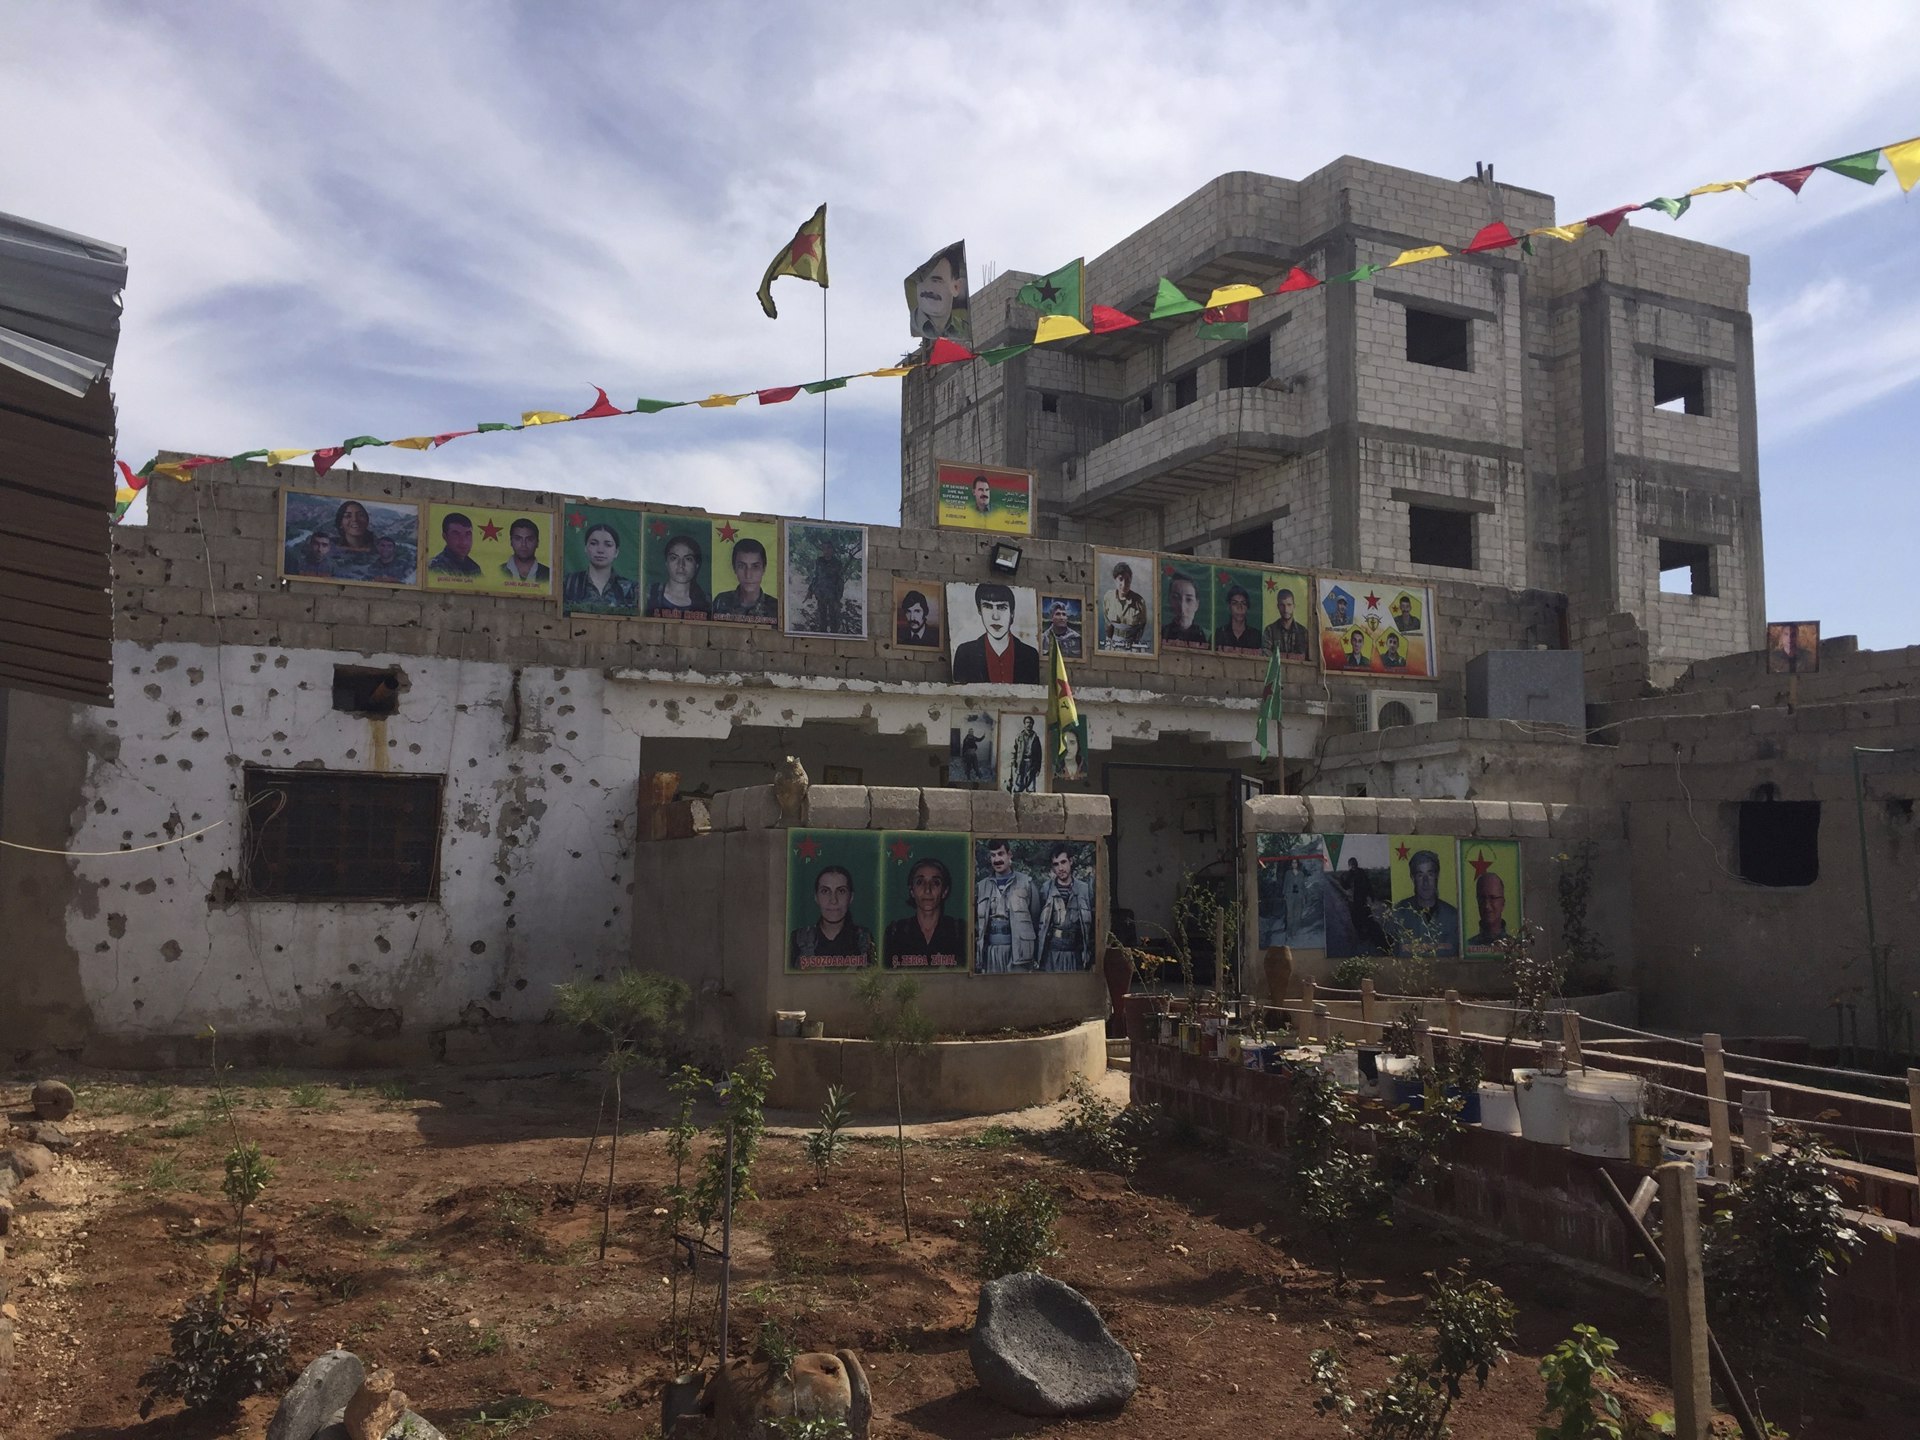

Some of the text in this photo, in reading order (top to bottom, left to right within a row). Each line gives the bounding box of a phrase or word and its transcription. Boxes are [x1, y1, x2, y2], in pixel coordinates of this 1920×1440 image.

[793, 848, 822, 864] YPJ
[886, 850, 914, 866] YPJ
[901, 954, 929, 966] ZERGA
